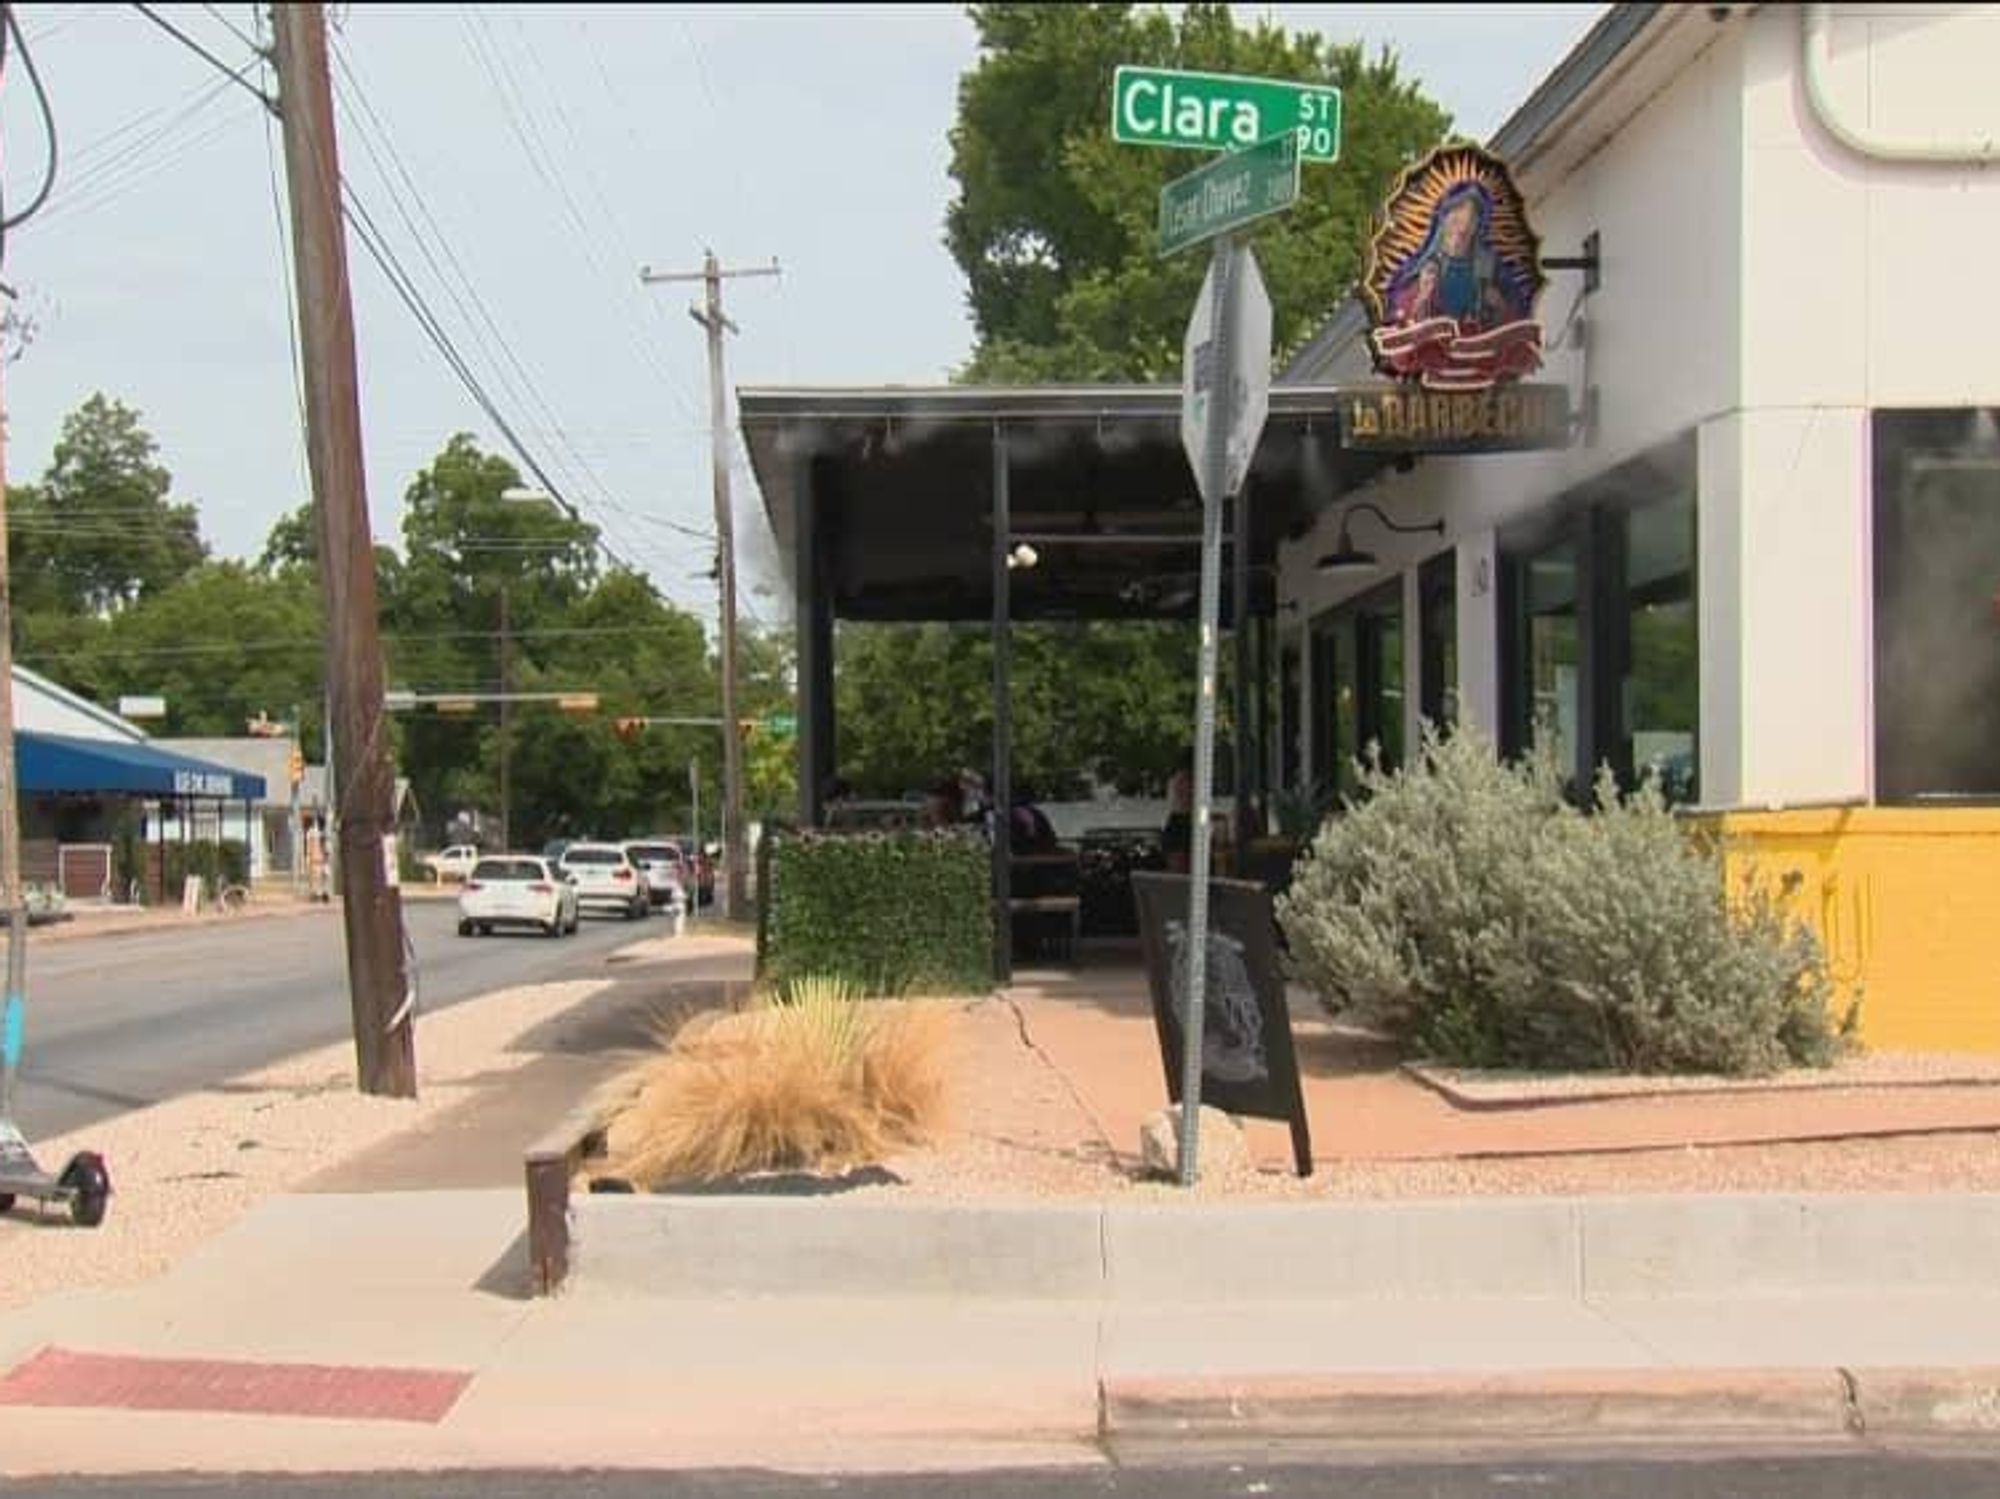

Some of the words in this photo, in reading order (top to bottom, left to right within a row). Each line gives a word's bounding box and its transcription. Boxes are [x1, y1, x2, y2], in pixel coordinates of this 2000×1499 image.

[1124, 79, 1260, 143] Clara
[1299, 91, 1332, 122] ST
[1297, 125, 1331, 154] 90
[1382, 393, 1562, 437] BARBECU
